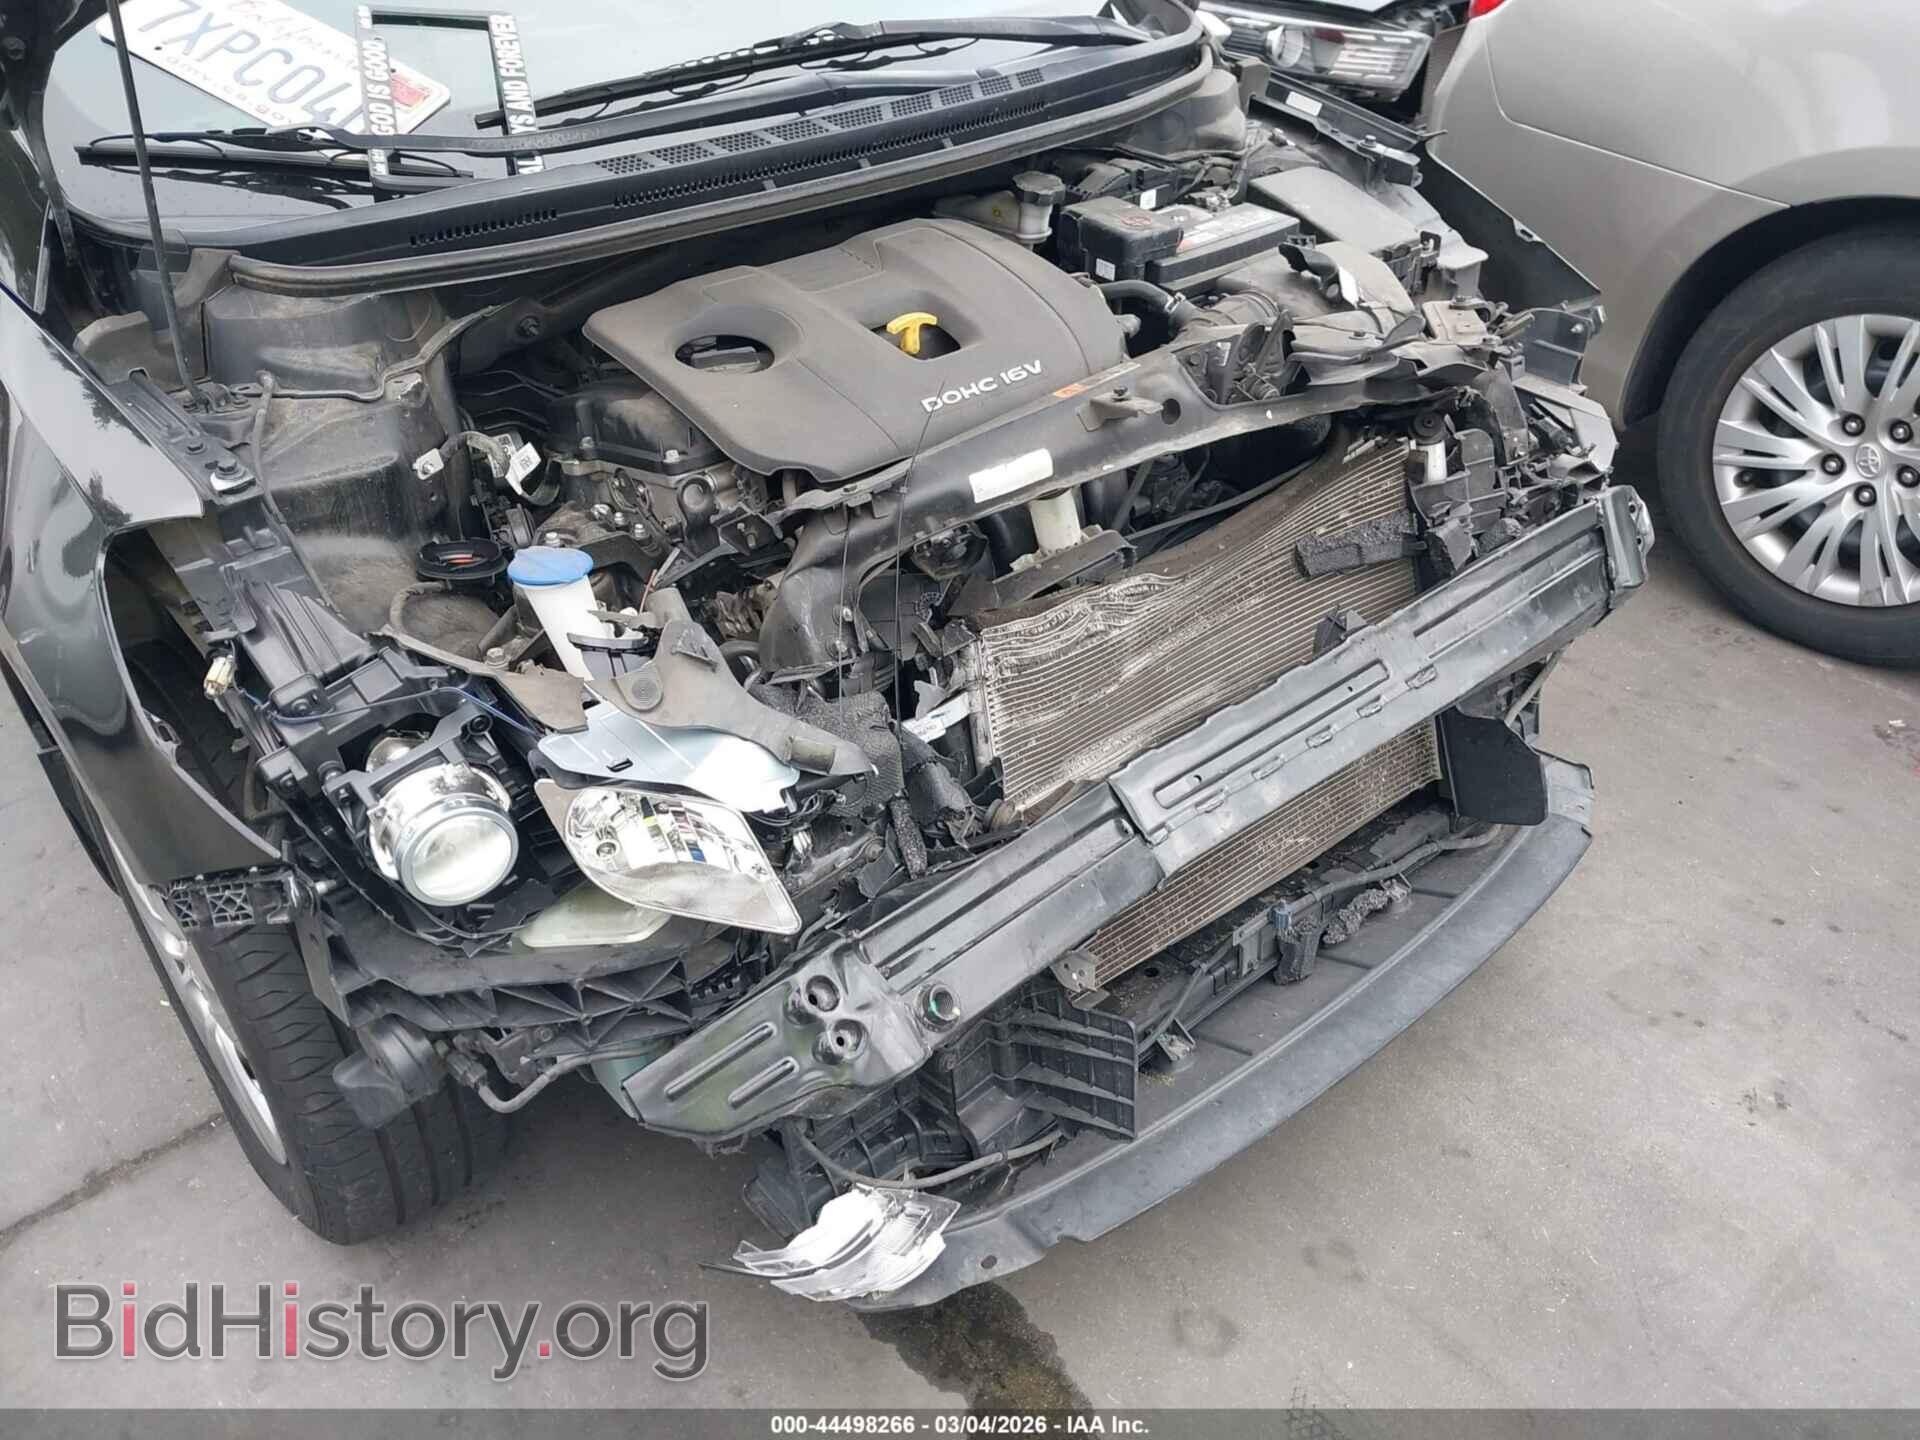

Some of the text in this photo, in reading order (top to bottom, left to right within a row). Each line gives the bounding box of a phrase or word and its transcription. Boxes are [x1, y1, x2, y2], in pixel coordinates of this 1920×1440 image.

[489, 14, 526, 78] FOREVER
[367, 83, 392, 101] IS
[502, 79, 533, 114] AND
[367, 102, 397, 135] GOD
[921, 359, 1042, 412] DOHC 16V
